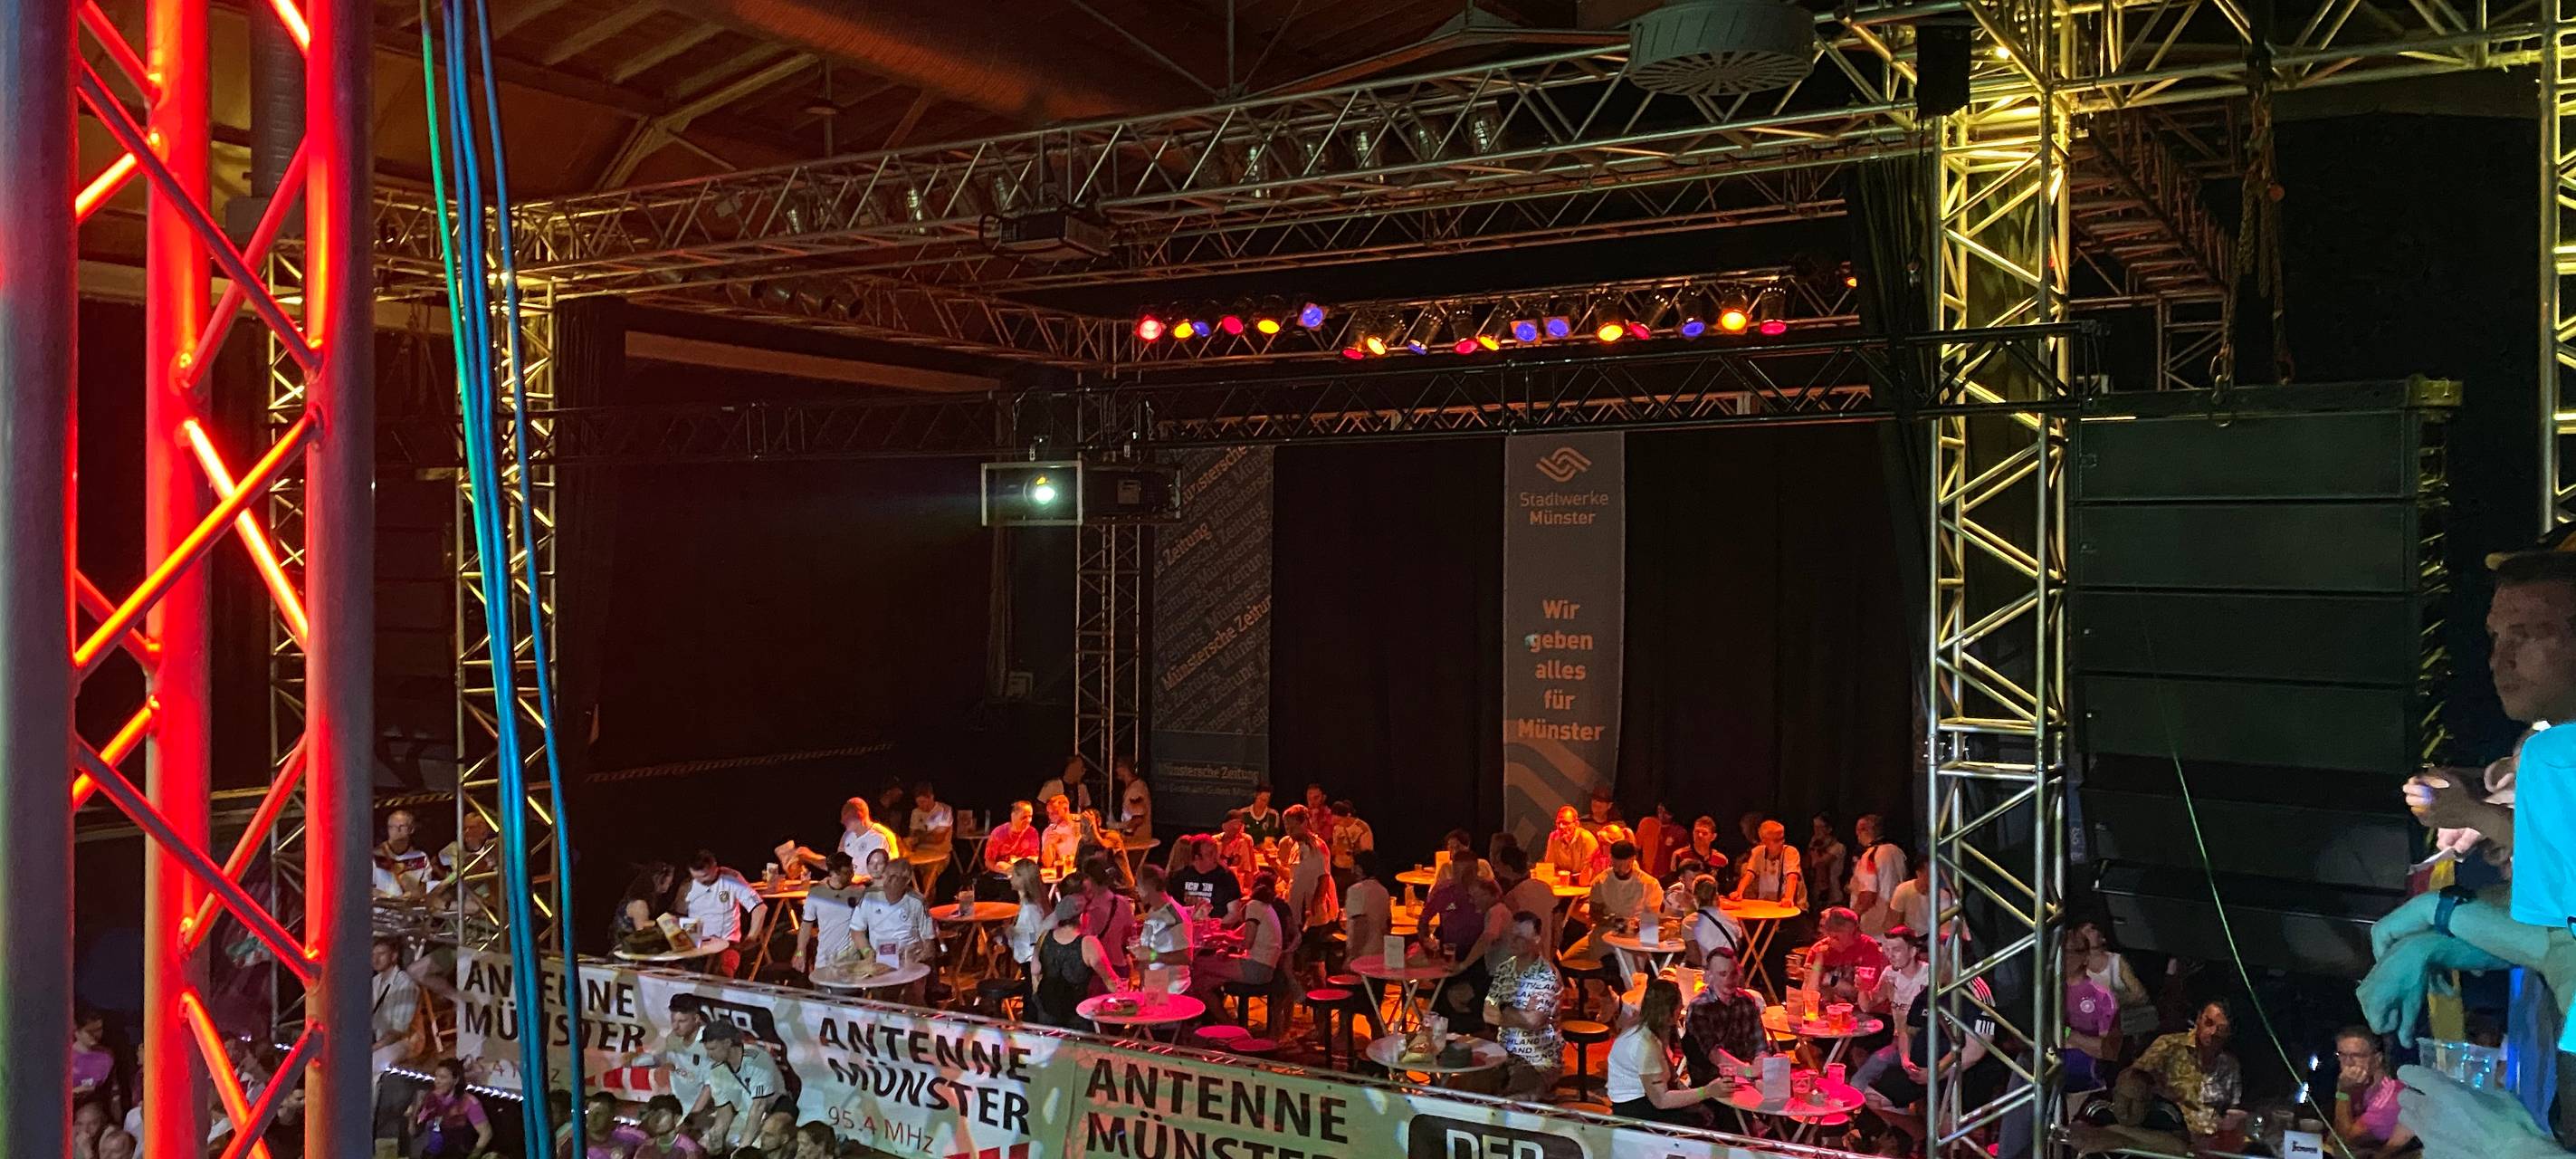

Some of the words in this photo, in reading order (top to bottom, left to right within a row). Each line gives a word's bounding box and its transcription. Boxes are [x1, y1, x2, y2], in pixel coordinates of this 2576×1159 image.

[1520, 491, 1608, 508] Stadtwerke
[1530, 510, 1596, 525] Münster
[1161, 522, 1213, 566] Zeitung
[1541, 599, 1580, 619] Wir
[1162, 627, 1238, 694] Münstersche
[1530, 631, 1594, 653] geben
[1535, 660, 1586, 680] alles
[1543, 689, 1576, 711] für
[1518, 718, 1605, 742] Münster
[464, 961, 635, 1019] ANENE
[819, 1018, 1031, 1084] ANTENNE
[827, 1058, 1030, 1135] MÜNSTER
[1086, 1058, 1349, 1145] ANTENNE
[828, 1106, 877, 1136] 95.4
[884, 1118, 934, 1154] MHz
[1086, 1110, 1346, 1159] MÜNS
